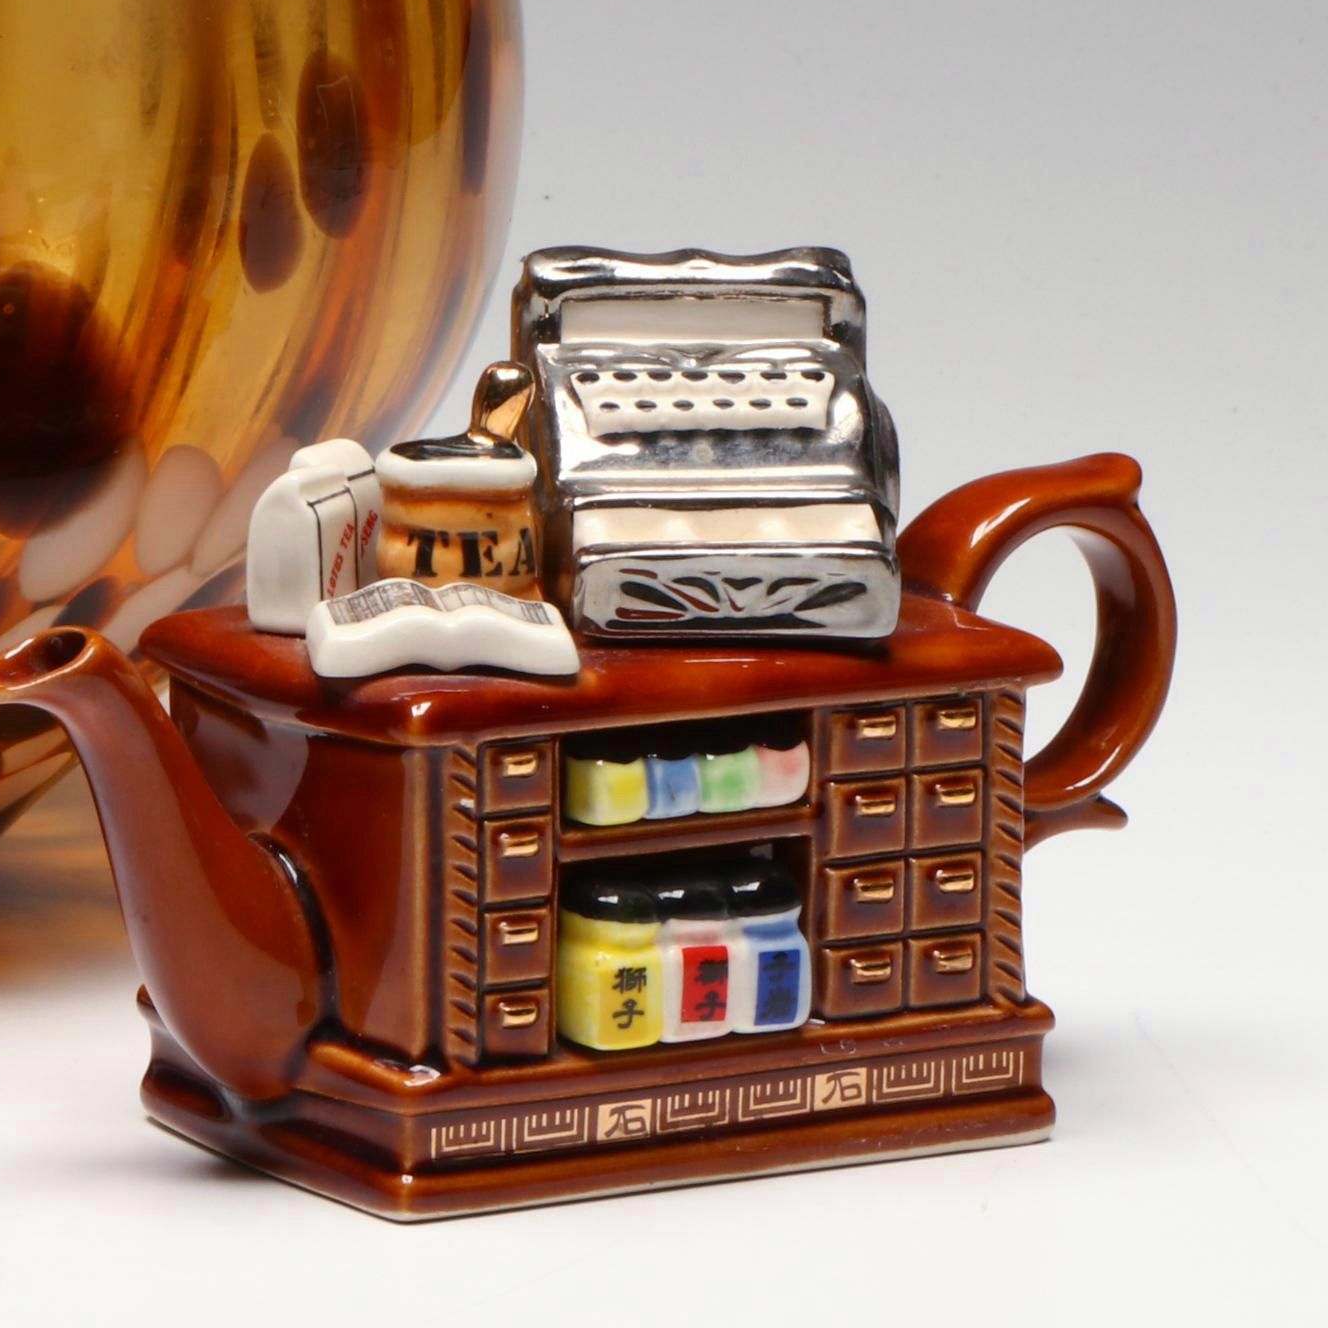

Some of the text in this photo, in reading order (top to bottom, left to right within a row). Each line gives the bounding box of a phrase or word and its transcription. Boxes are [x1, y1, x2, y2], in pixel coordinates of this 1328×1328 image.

[340, 522, 354, 550] TEA
[407, 528, 535, 578] TEA
[612, 966, 647, 1029] 獅子
